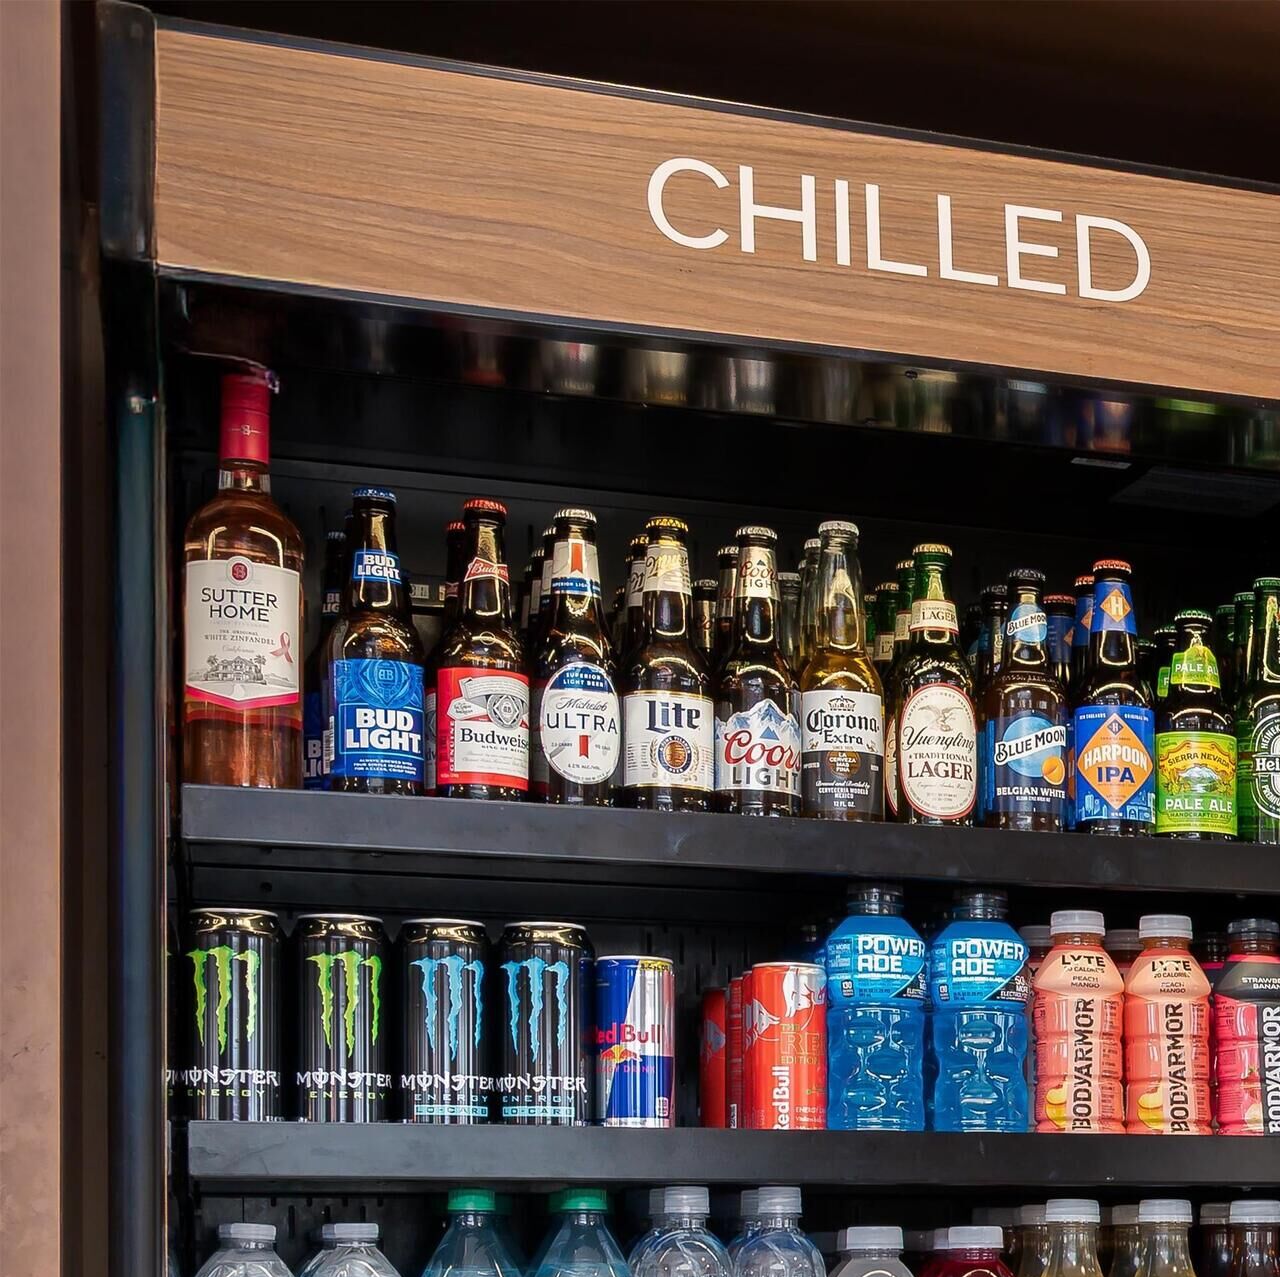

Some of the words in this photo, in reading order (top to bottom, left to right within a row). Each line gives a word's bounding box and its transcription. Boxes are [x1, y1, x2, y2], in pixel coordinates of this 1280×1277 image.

[647, 158, 1150, 302] CHILLED
[363, 555, 396, 568] BUD
[357, 565, 400, 580] LIGHT
[201, 588, 278, 608] SUTTER
[209, 605, 270, 622] HOME
[922, 610, 956, 623] LAGER
[556, 697, 608, 712] Michelob
[356, 708, 414, 732] BUD
[546, 712, 618, 734] ULTRA
[646, 700, 700, 734] Lite
[807, 709, 880, 733] Corona
[346, 729, 421, 753] LIGHT
[824, 730, 863, 745] Extra
[902, 726, 974, 752] Yuengling
[996, 742, 1033, 762] BLUE
[1034, 728, 1065, 748] MOON
[1084, 743, 1148, 771] HARPOON
[908, 762, 973, 782] LAGER
[1097, 766, 1135, 783] IPA
[1165, 799, 1203, 811] PALE
[1209, 800, 1232, 812] ALE
[857, 936, 925, 957] POWER
[952, 940, 1024, 960] POWER
[857, 955, 902, 973] ADE
[952, 958, 996, 976] ADE
[1071, 998, 1094, 1132] BODYARMOR
[296, 1068, 392, 1089] MONSTER
[309, 1091, 385, 1099] ENERGY
[414, 1093, 488, 1102] ENERGY
